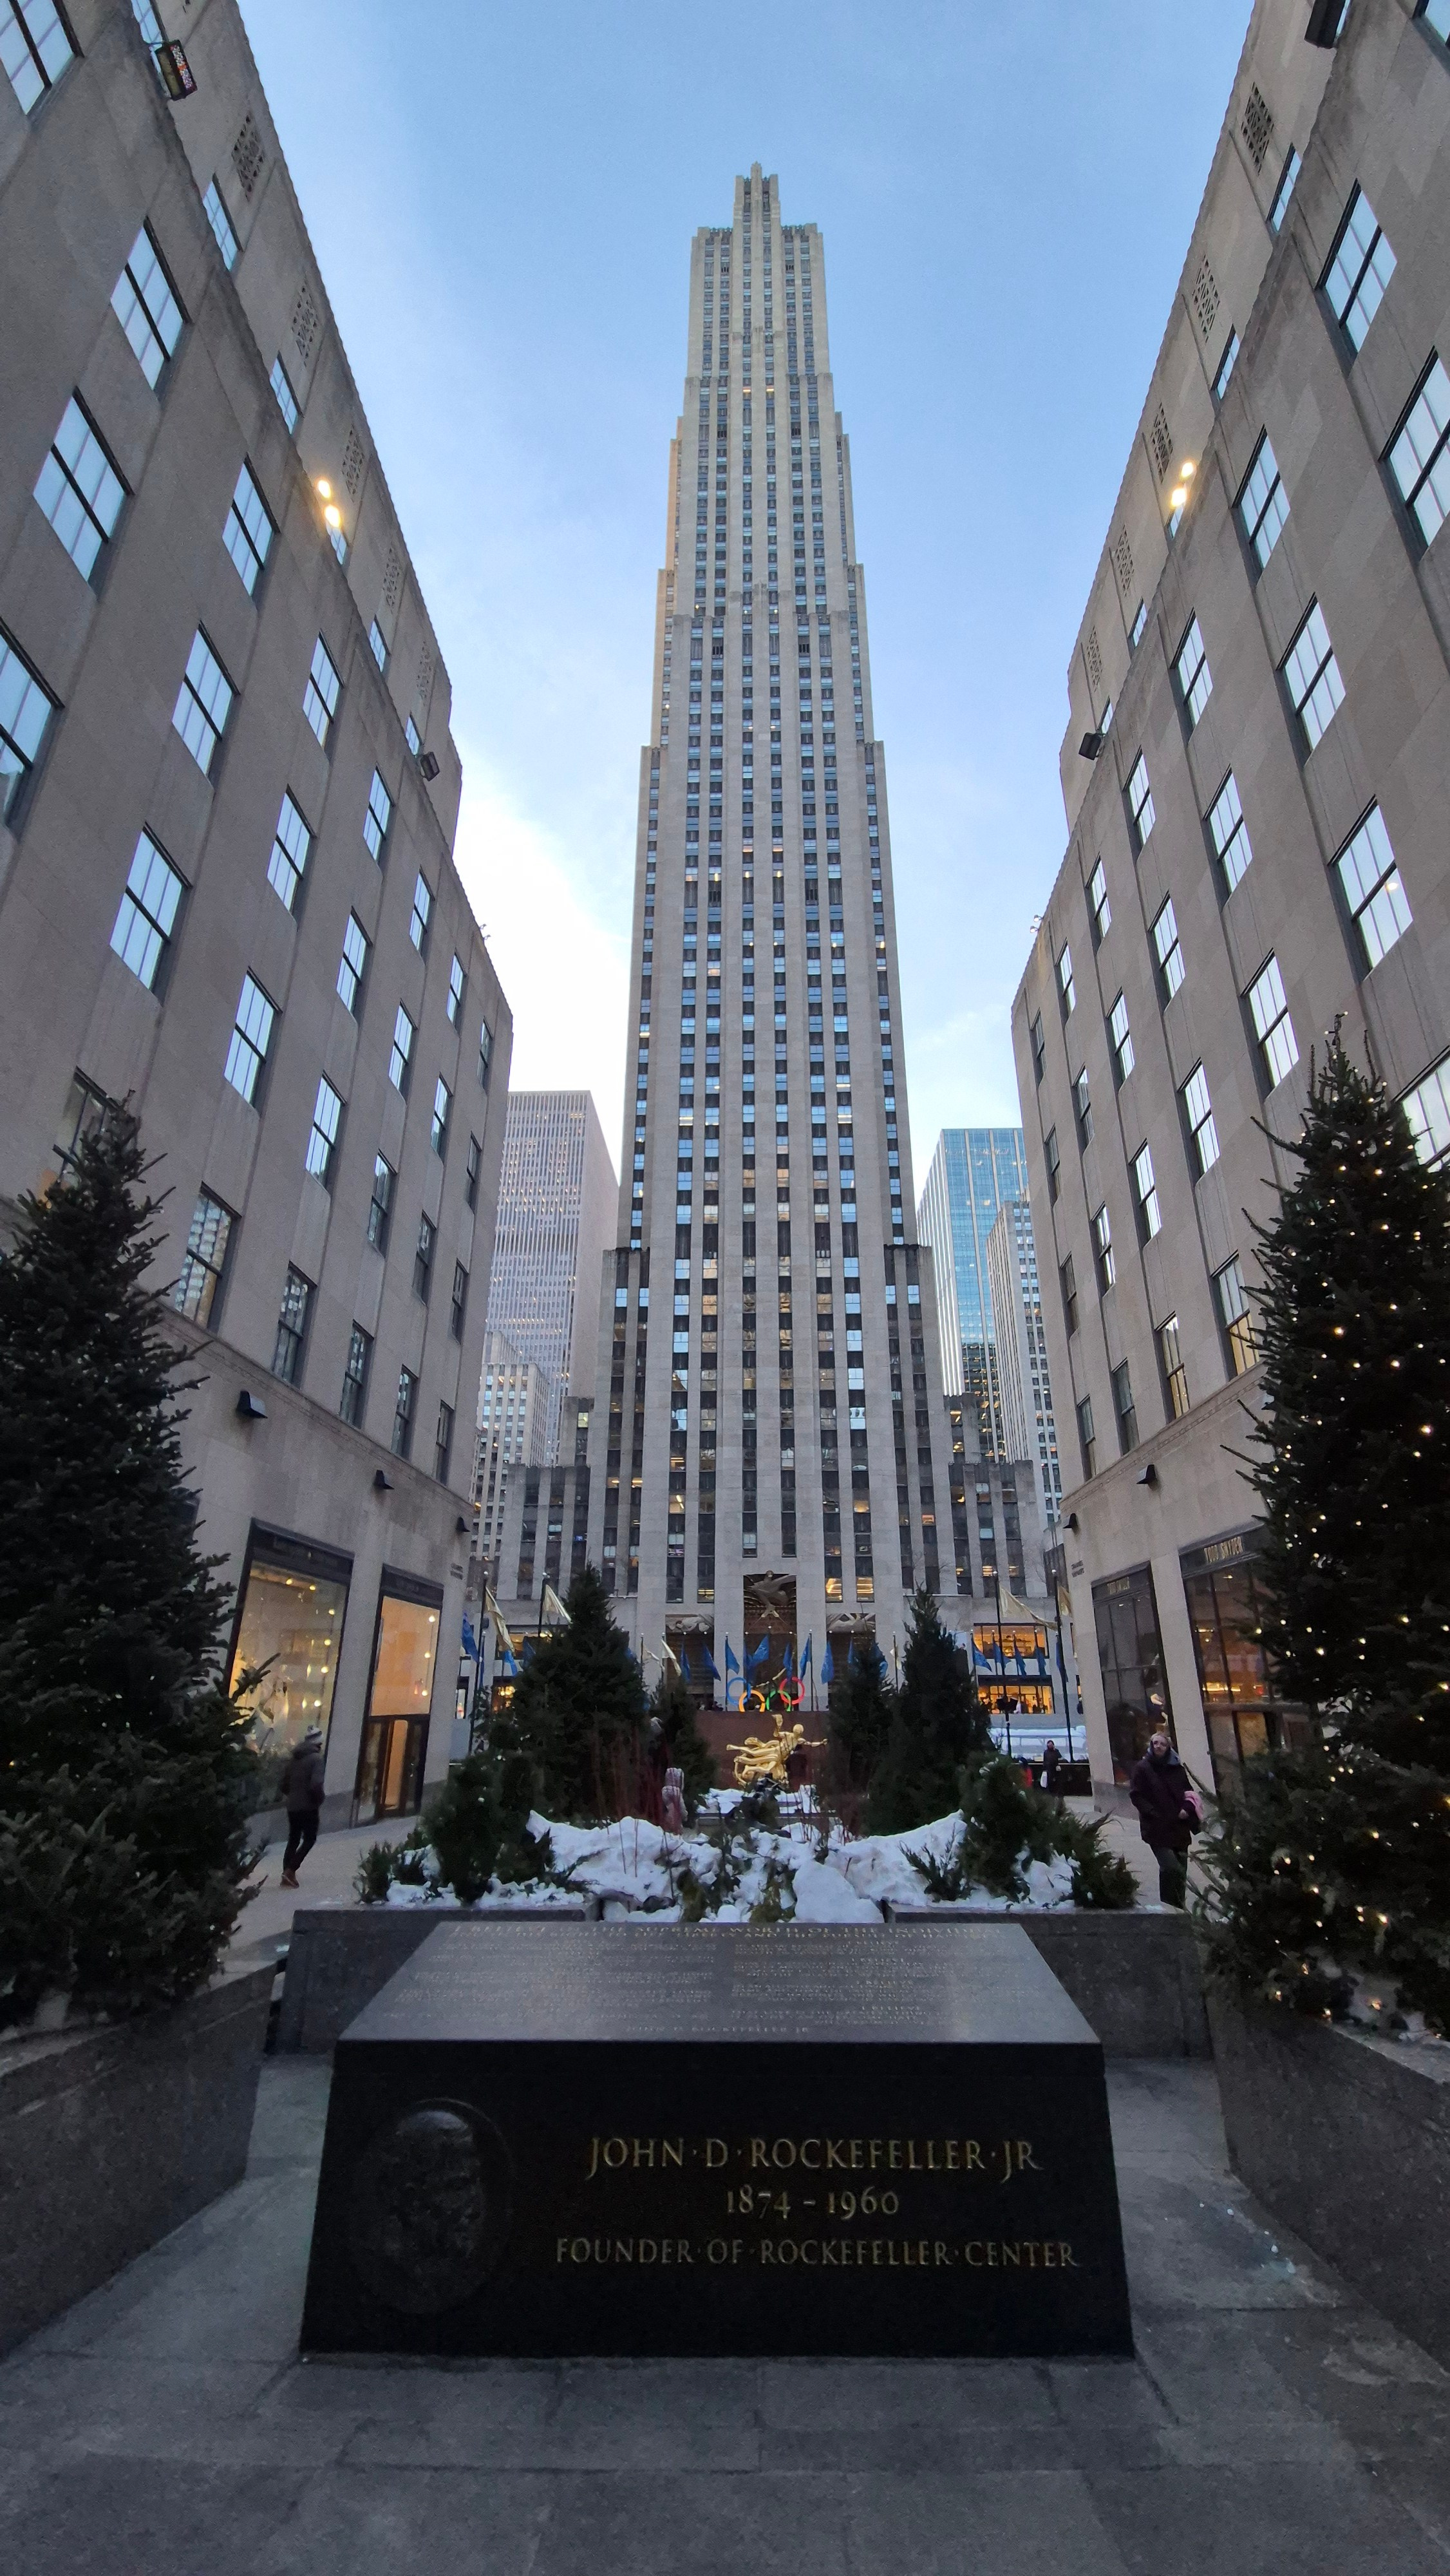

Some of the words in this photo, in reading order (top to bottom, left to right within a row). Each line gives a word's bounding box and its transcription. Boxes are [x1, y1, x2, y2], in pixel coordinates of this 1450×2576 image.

[586, 2137, 684, 2180] JOHN
[706, 2138, 728, 2168] D
[751, 2138, 986, 2170] ROCKEFELLER
[1001, 2139, 1044, 2184] JR
[727, 2184, 791, 2219] 1874
[828, 2186, 899, 2220] 1960
[556, 2237, 694, 2264] FOUNDER
[708, 2239, 744, 2264] OF
[761, 2239, 953, 2266] ROCKEFELLER
[966, 2241, 1080, 2268] CENTER
